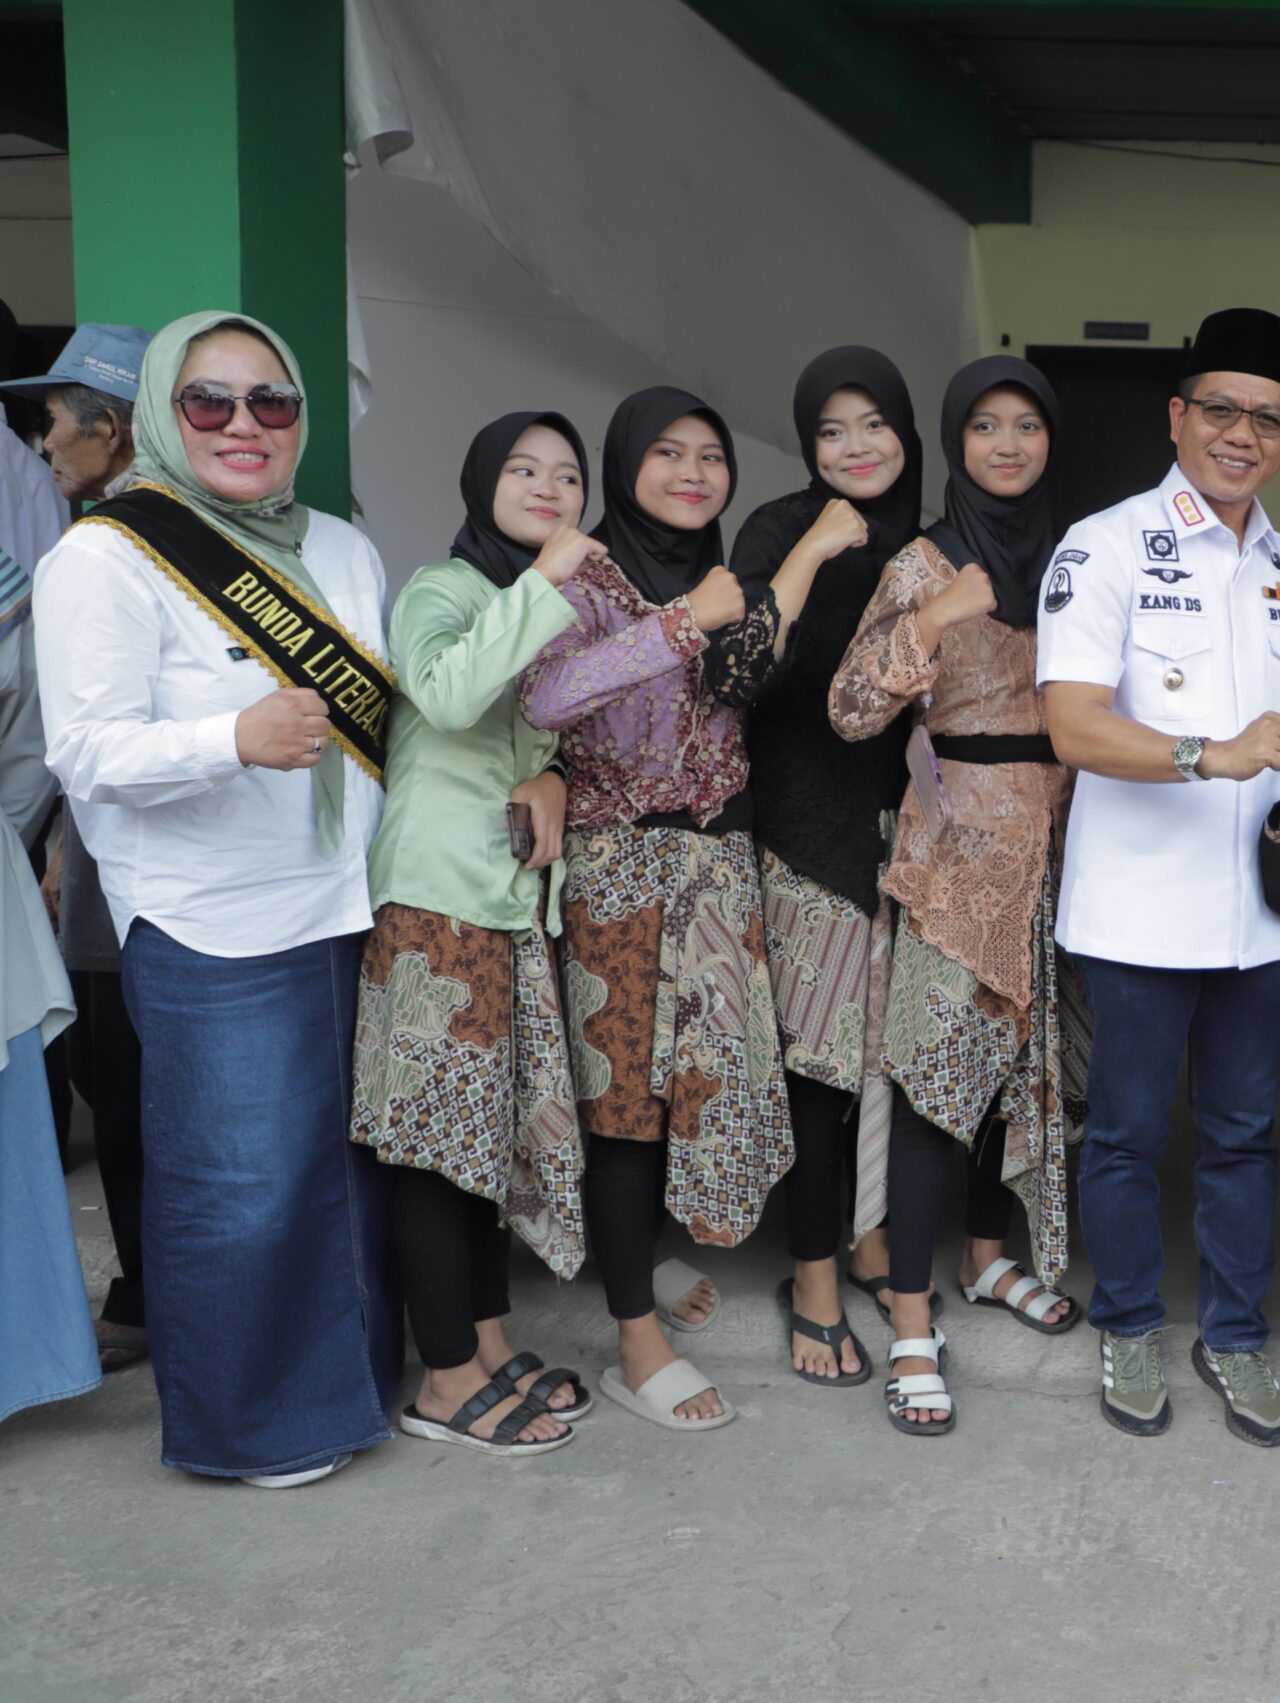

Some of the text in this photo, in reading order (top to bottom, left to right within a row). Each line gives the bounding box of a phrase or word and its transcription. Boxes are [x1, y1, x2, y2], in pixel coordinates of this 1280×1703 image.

[222, 571, 314, 657] BUNDA
[1139, 594, 1202, 613] KANG DS
[302, 642, 390, 745] LITERAS
